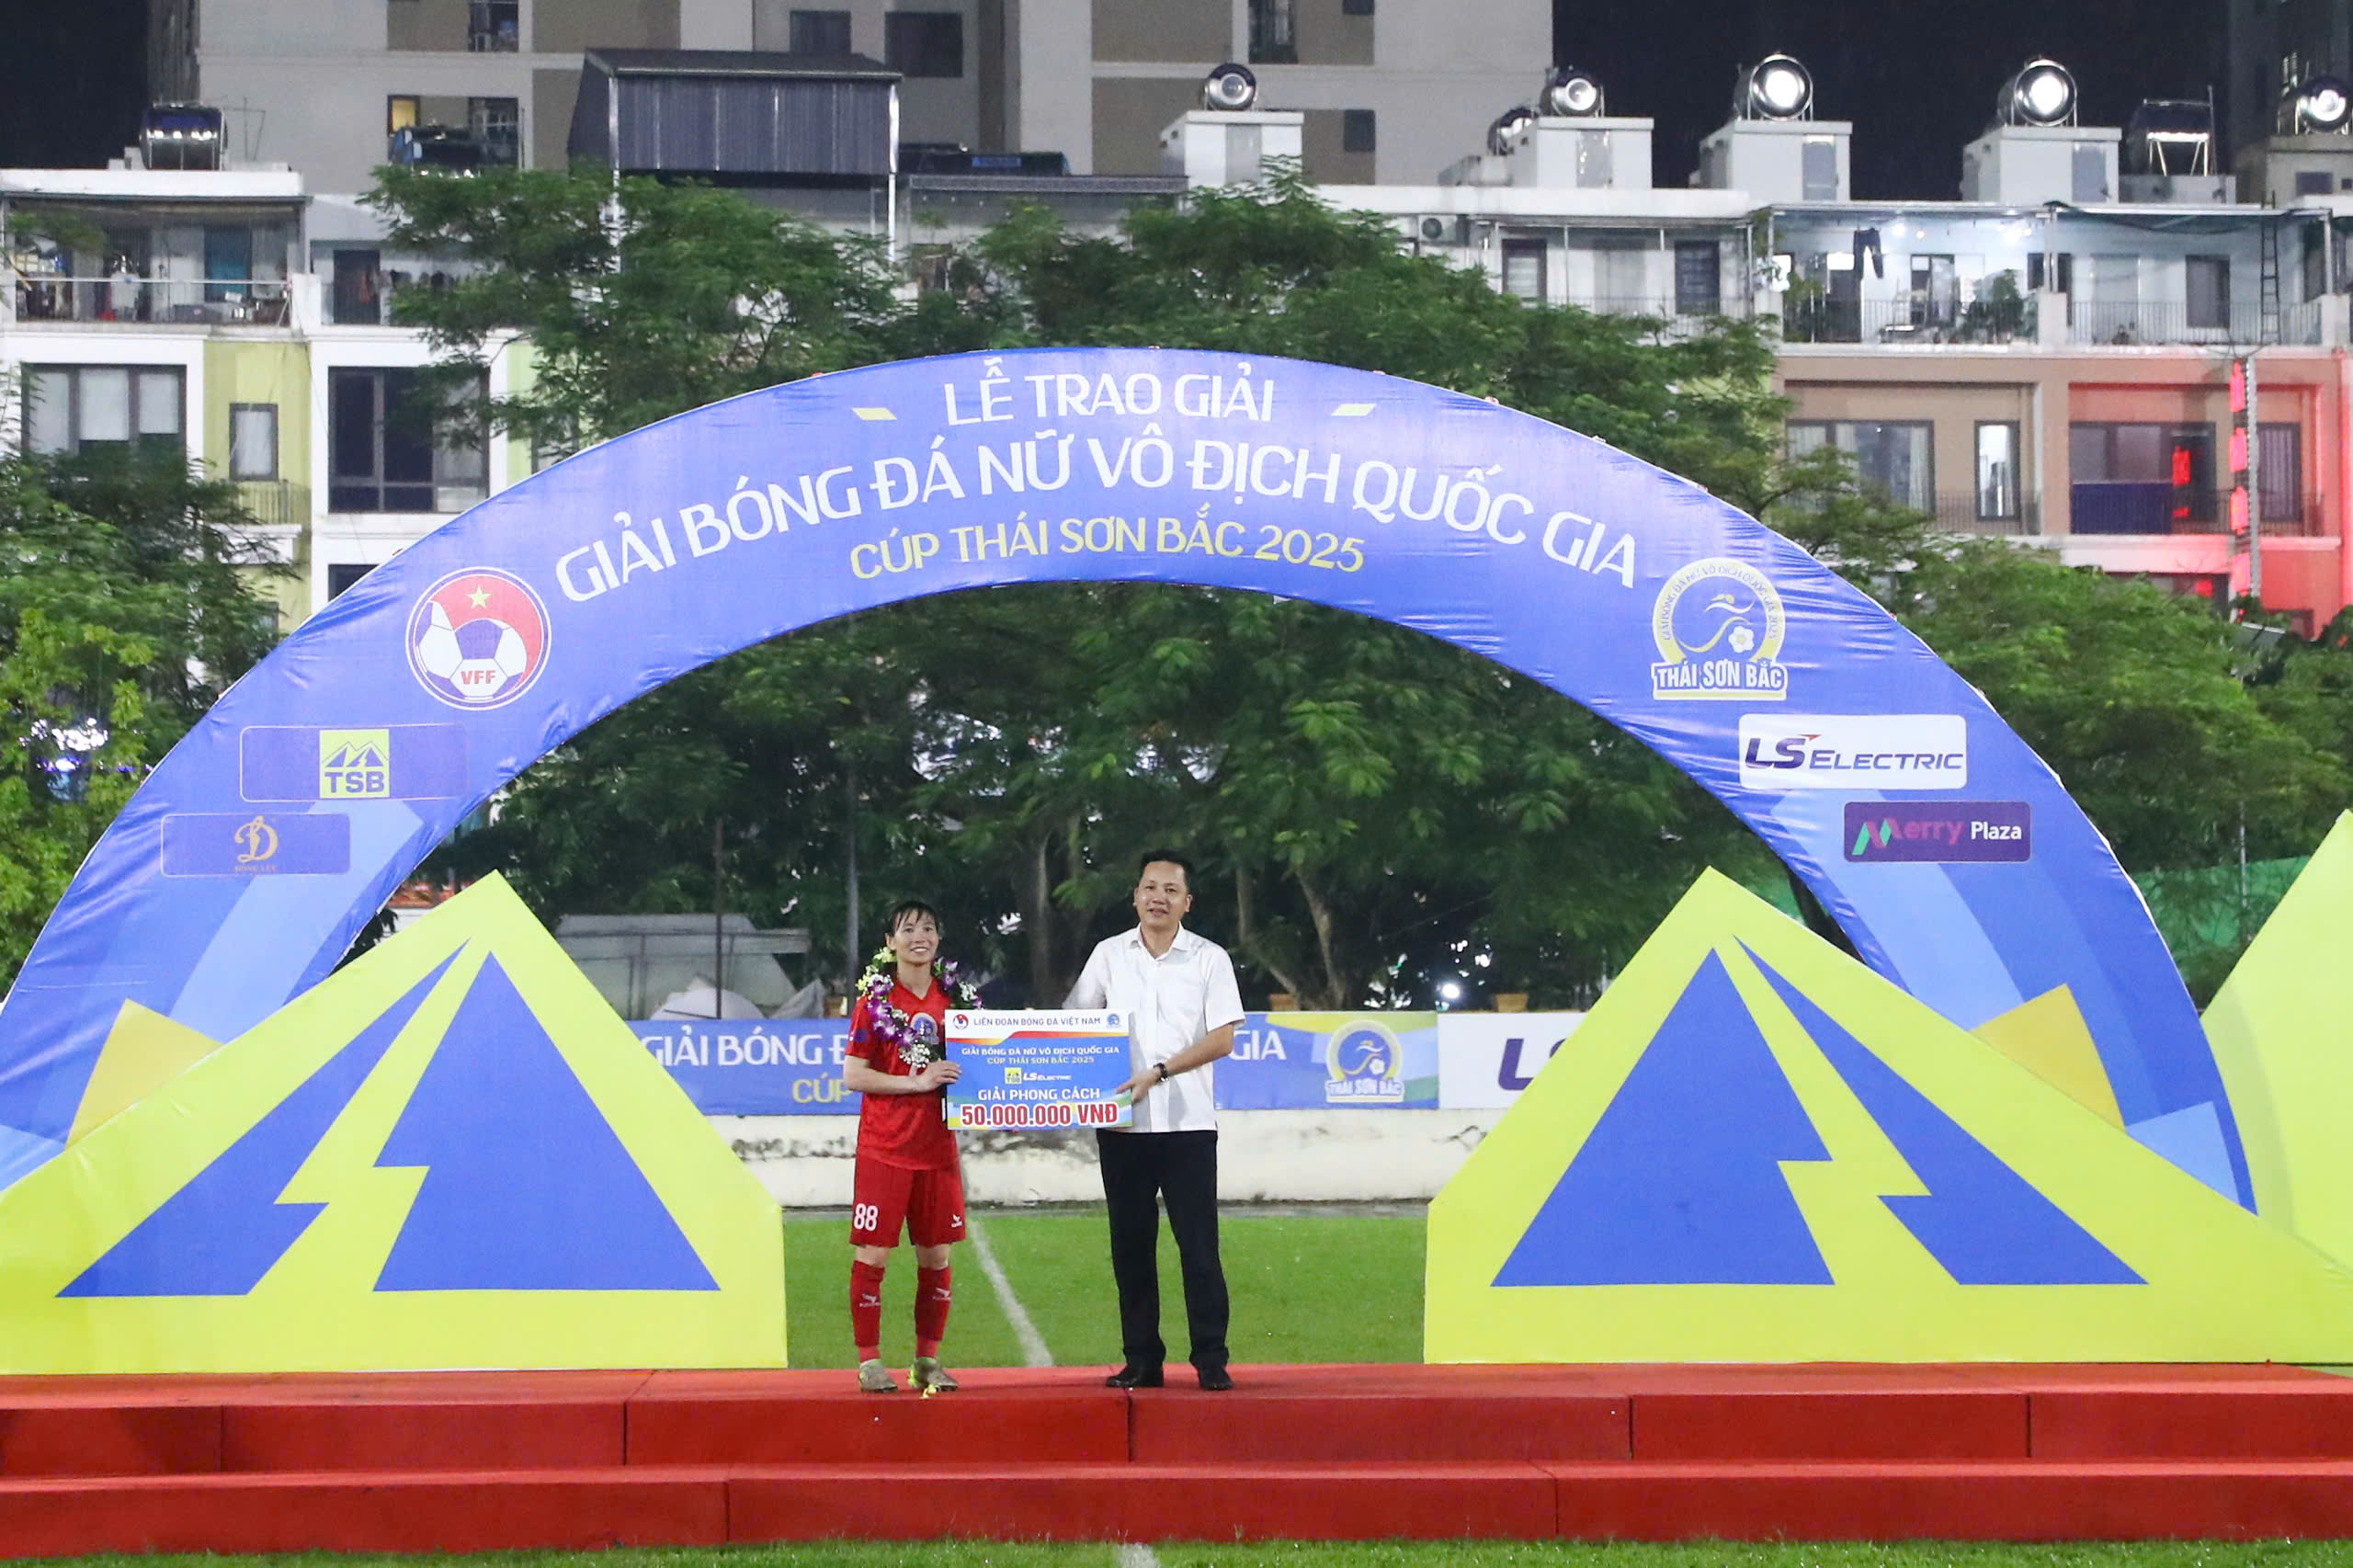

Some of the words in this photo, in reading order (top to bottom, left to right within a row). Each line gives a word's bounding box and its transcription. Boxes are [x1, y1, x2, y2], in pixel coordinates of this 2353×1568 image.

[945, 357, 1013, 426] LỄ
[1025, 373, 1161, 416] TRAO
[1175, 362, 1273, 422] GIẢI
[555, 511, 677, 603] GIẢI
[679, 465, 862, 559] BÓNG
[870, 435, 964, 509] ĐÁ
[978, 430, 1074, 494] NỮ
[1087, 423, 1173, 487] VÔ
[1186, 439, 1341, 505] ĐỊCH
[1352, 460, 1534, 545] QUỐC
[1542, 511, 1635, 588] GIA
[850, 528, 940, 579] CÚP
[949, 511, 1049, 562] THÁI
[1060, 516, 1147, 553] SƠN
[1156, 503, 1245, 556] BẮC
[1254, 524, 1366, 573] 2025
[460, 670, 496, 684] VFF
[1657, 661, 1698, 687] THÁI
[1703, 658, 1740, 687] SƠN
[1746, 661, 1781, 687] BẮC
[324, 771, 384, 793] TSB
[1851, 817, 1965, 856] Merry
[1971, 821, 2022, 841] Plaza
[973, 1017, 993, 1026] LIÊN
[1061, 1016, 1079, 1026] VIỆT
[718, 1026, 823, 1065] BÓNG
[1228, 1029, 1287, 1061] GIA
[1076, 1045, 1102, 1055] QUỐC
[1104, 1046, 1120, 1054] GIA
[793, 1072, 854, 1103] CÚP
[978, 1086, 1006, 1100] GIẢI
[1009, 1089, 1057, 1100] PHONG
[1062, 1085, 1100, 1099] CÁCH
[961, 1105, 1071, 1126] 50.000.000
[1077, 1103, 1118, 1124] VNĐ
[853, 1203, 879, 1231] 88
